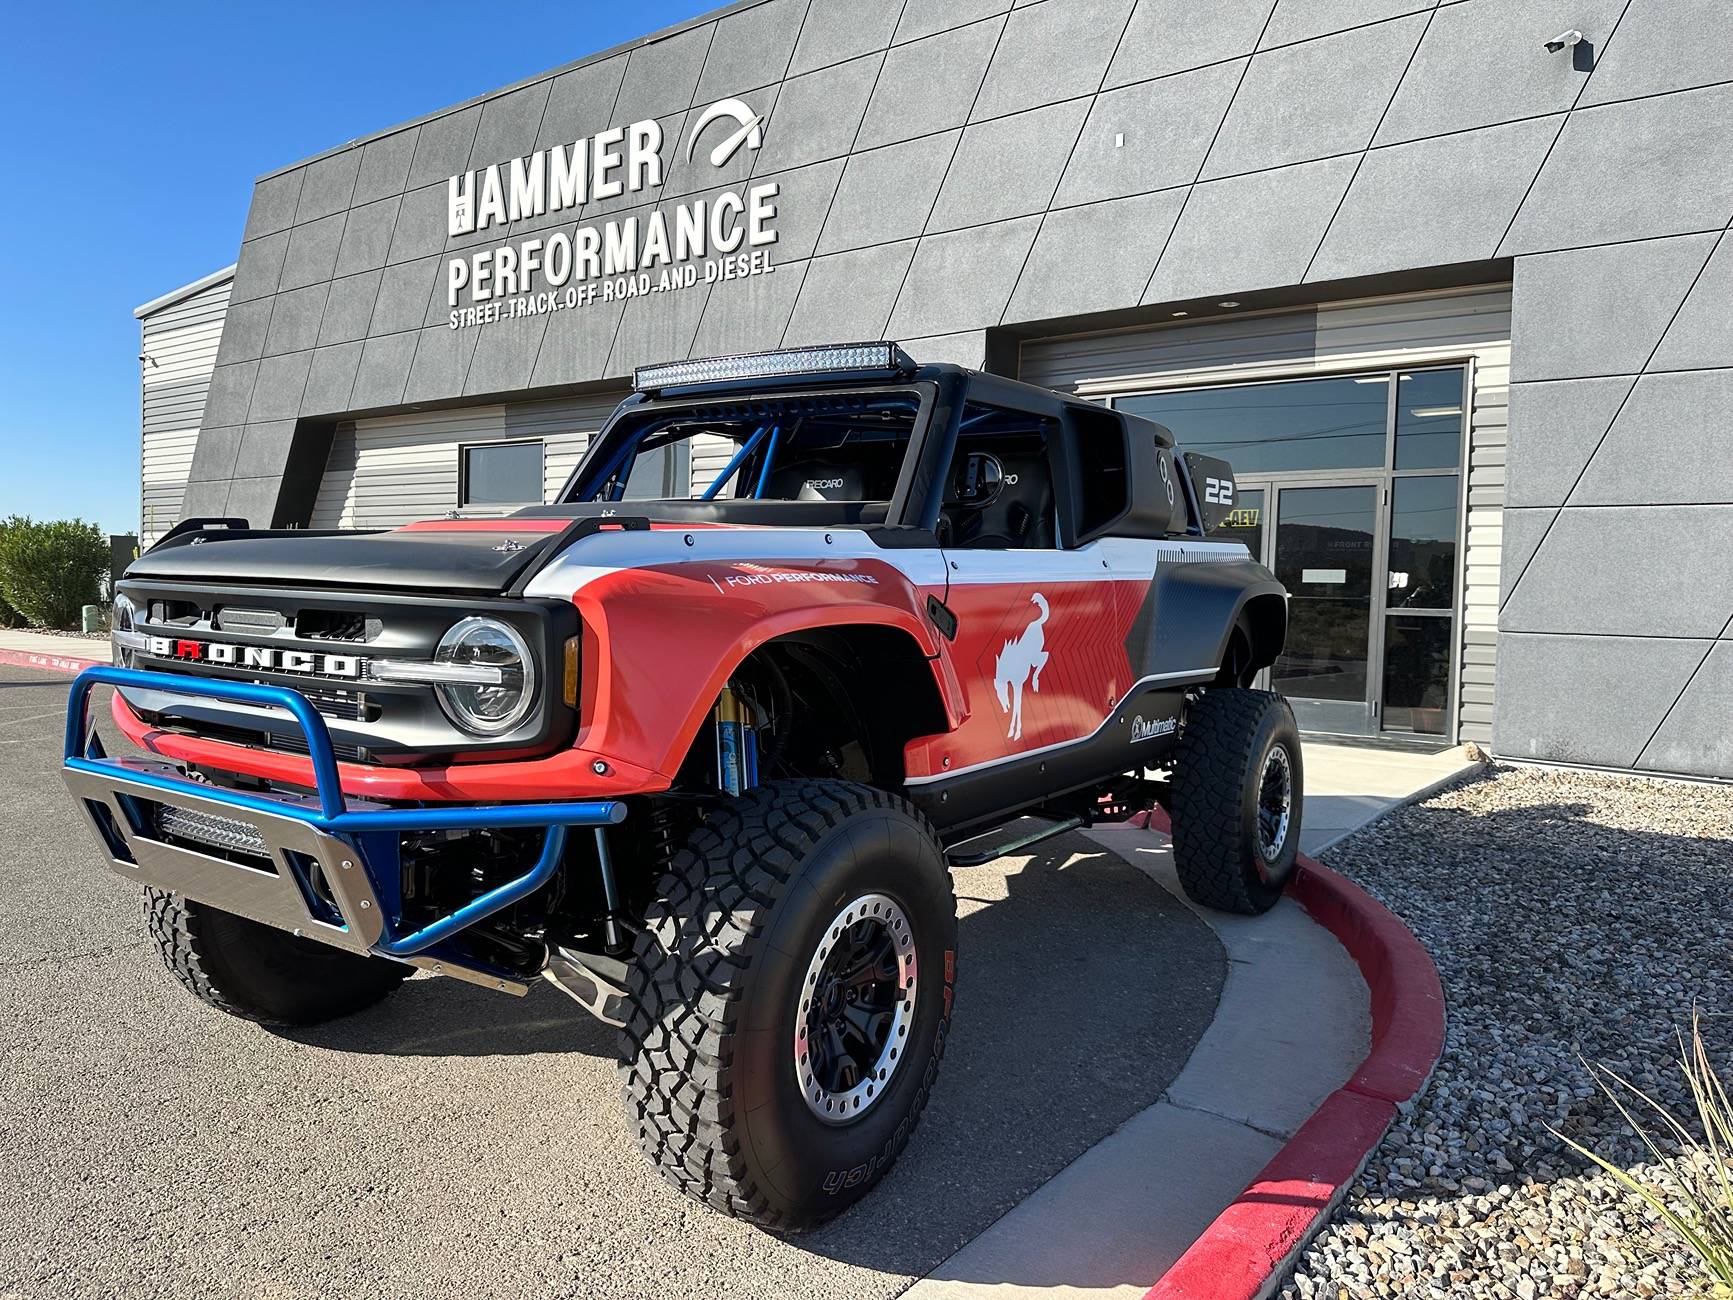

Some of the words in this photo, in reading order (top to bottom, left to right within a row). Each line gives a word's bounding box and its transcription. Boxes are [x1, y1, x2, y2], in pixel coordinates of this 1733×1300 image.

[449, 119, 664, 237] HAMMER
[448, 182, 780, 307] PERFORMANCE
[704, 250, 775, 284] DIESEL
[807, 478, 843, 489] RECARO
[1205, 477, 1233, 506] 22
[1230, 509, 1259, 527] AEV
[725, 574, 772, 587] FORD
[771, 573, 879, 585] PERFORMANCE
[150, 636, 360, 677] BRONCO
[1141, 716, 1176, 738] Multimatic
